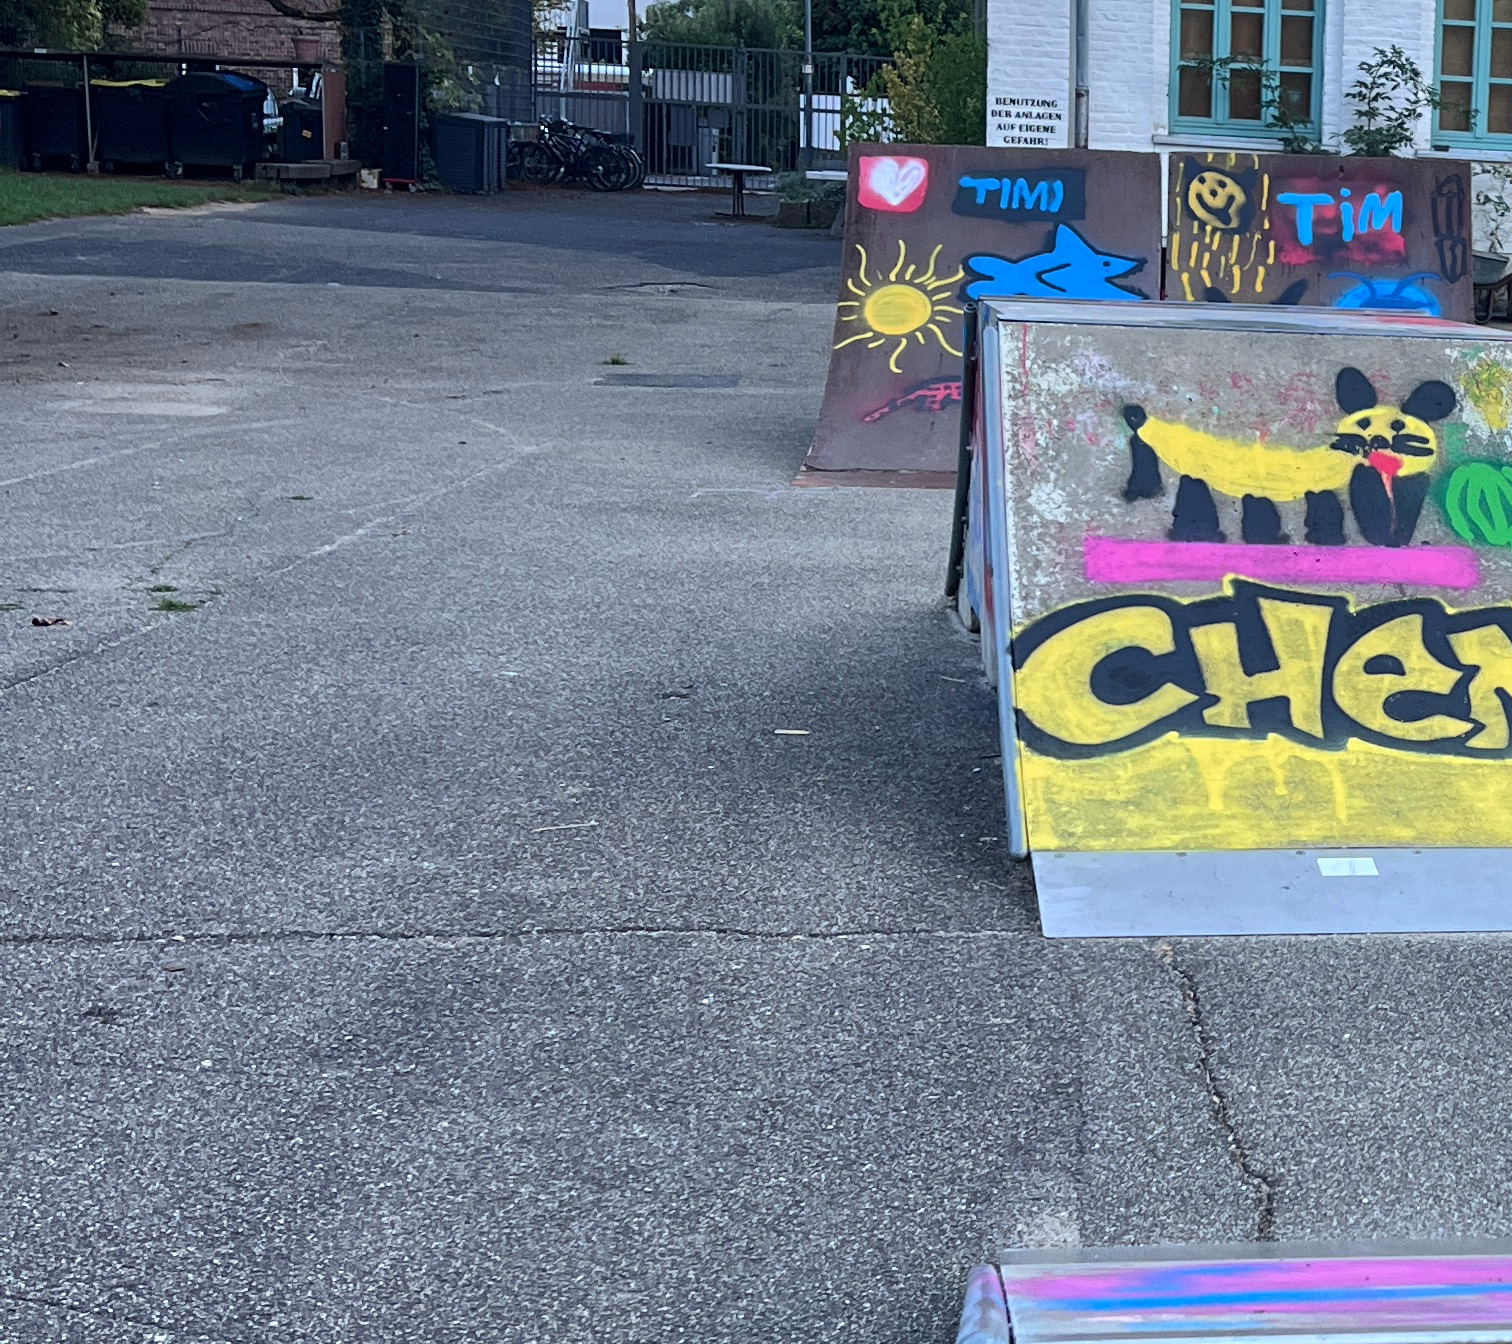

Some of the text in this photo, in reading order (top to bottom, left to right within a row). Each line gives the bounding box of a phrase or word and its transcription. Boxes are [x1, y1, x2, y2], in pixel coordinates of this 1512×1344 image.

[995, 97, 1058, 108] BENUTZUNG
[991, 109, 1062, 120] DER ANLAGEN
[996, 123, 1057, 134] AUF EIGENE
[1003, 136, 1049, 146] GEFAHR!
